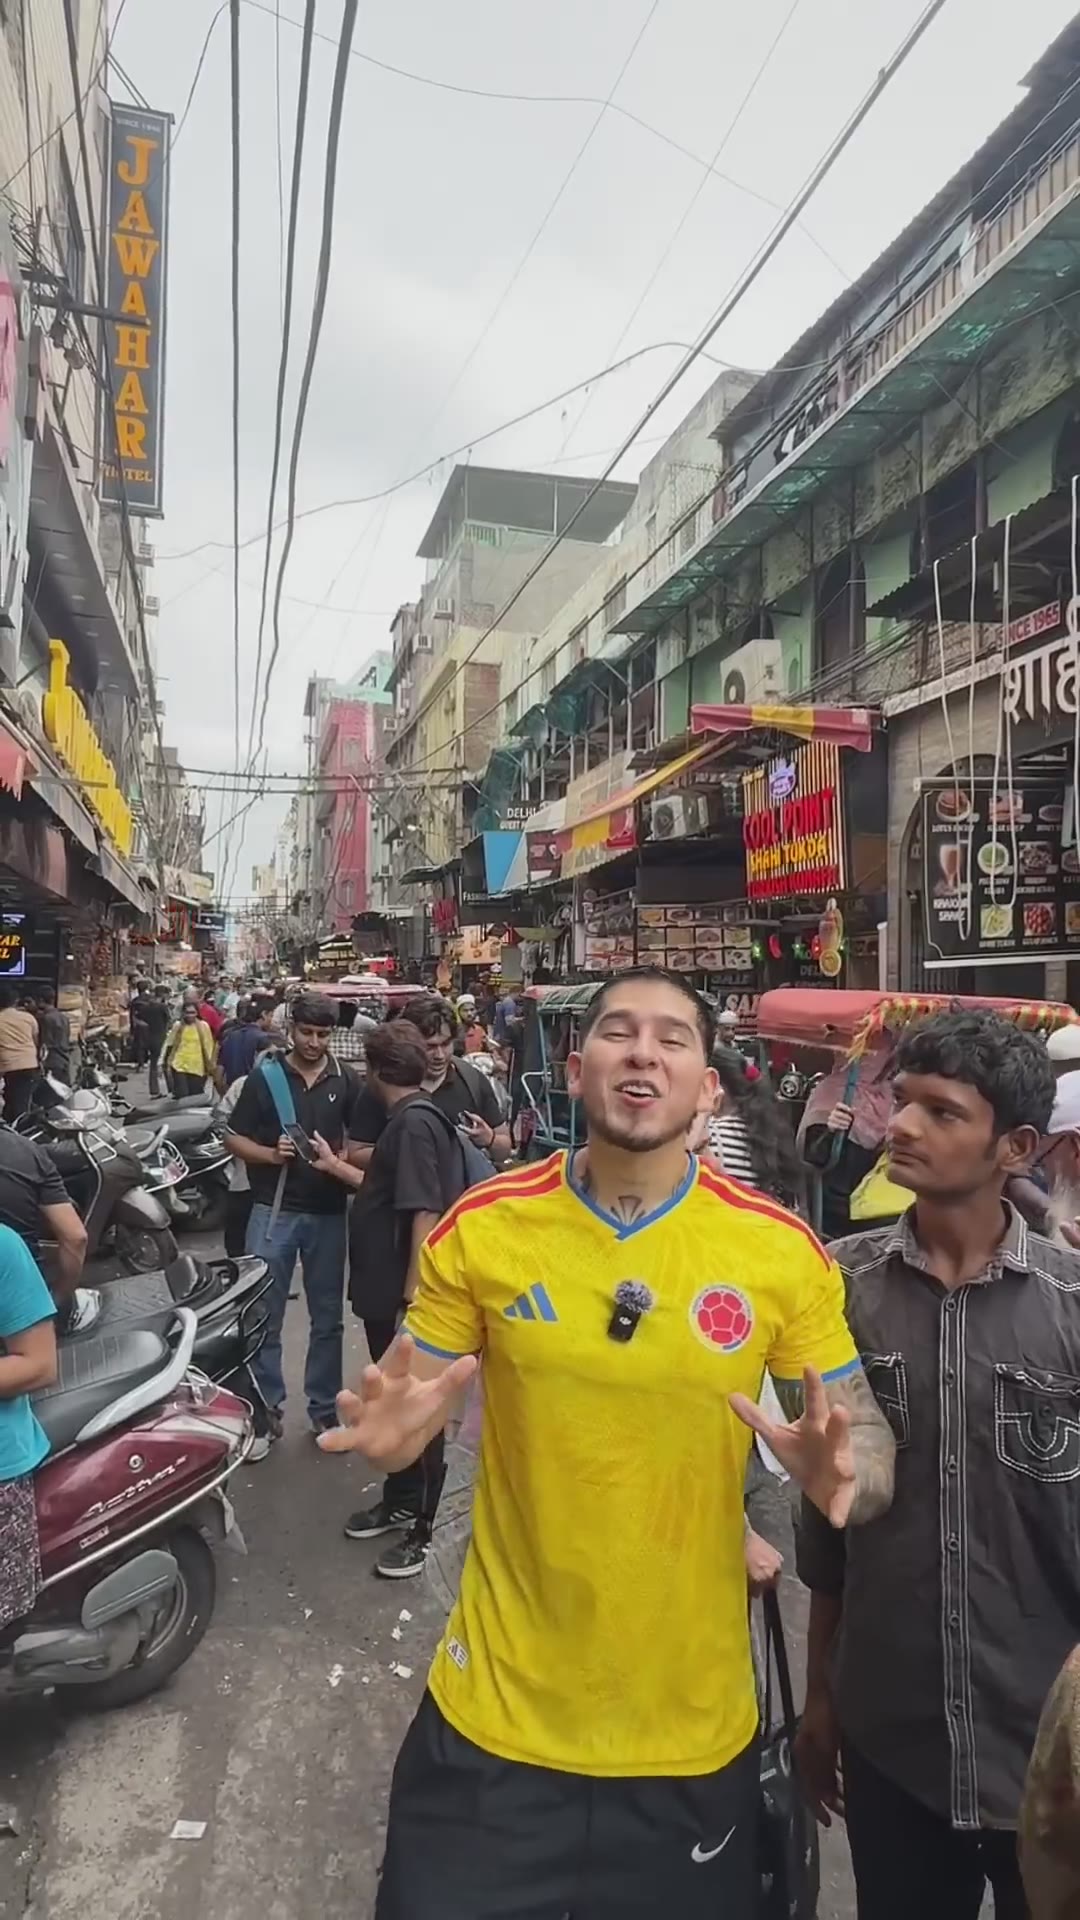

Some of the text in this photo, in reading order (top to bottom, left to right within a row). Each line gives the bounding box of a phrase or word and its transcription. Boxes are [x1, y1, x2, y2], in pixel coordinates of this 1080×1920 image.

[112, 135, 160, 459] JAWAHAR
[998, 603, 1059, 647] SNCE 1965
[507, 807, 536, 818] DELHI
[743, 787, 834, 850] COOL POINT
